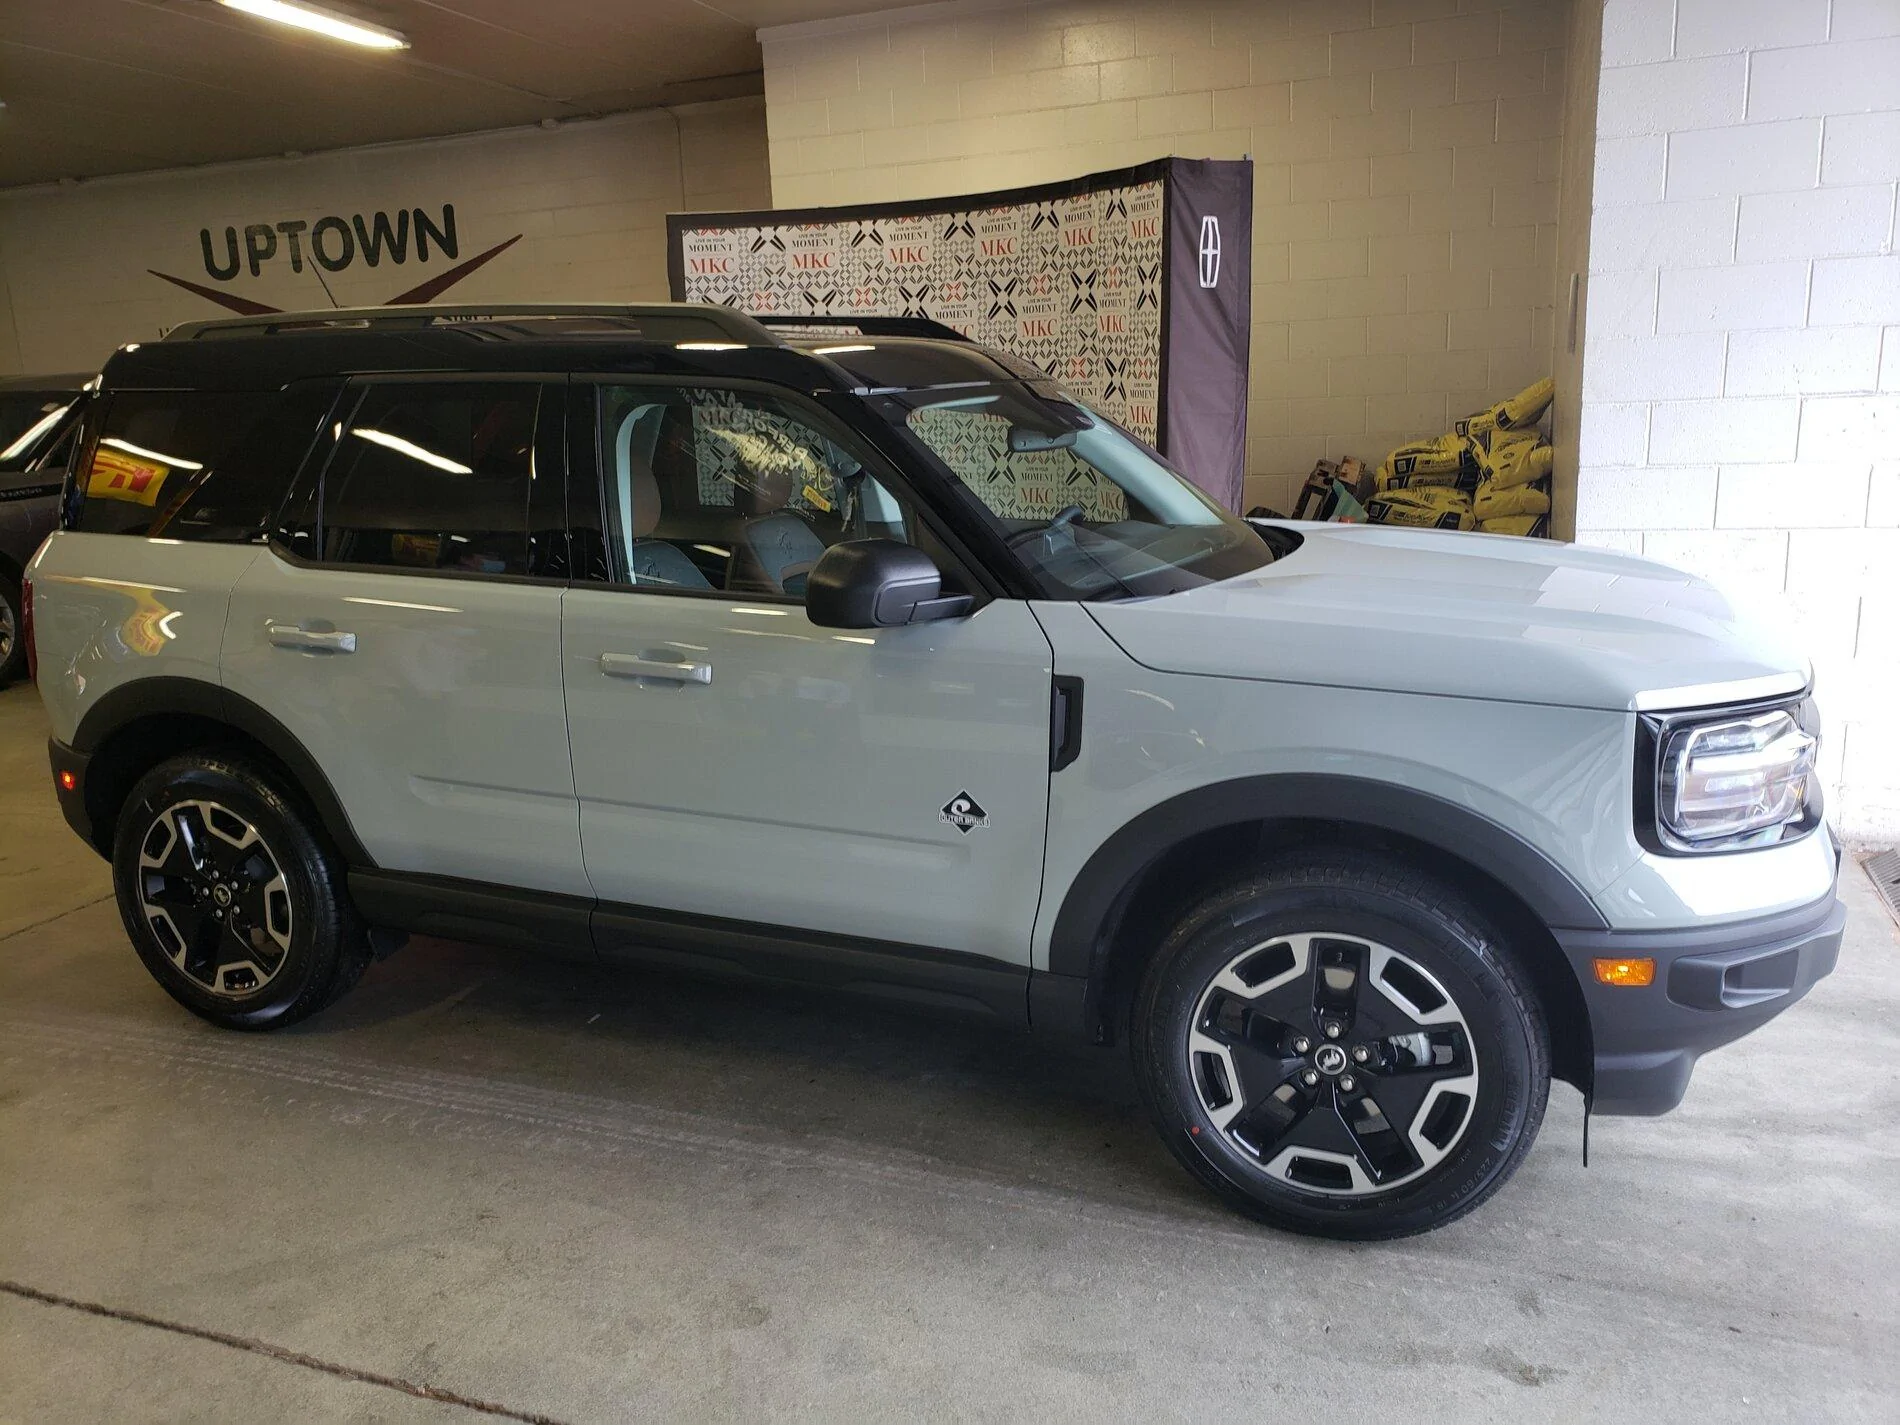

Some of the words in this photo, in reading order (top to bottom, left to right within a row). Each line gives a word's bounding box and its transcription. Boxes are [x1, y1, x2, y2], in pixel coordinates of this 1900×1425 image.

[1130, 199, 1159, 213] MOMENT
[1064, 209, 1096, 223] MOMENT
[981, 221, 1017, 234] MOMENT
[1131, 216, 1160, 239] MKC
[200, 204, 459, 281] UPTOWN
[792, 238, 835, 248] MOMENT
[889, 231, 928, 242] MOMENT
[1064, 226, 1097, 247] MKC
[689, 243, 732, 252] MOMENT
[980, 236, 1018, 257] MKC
[792, 251, 836, 270] MKC
[889, 245, 929, 264] MKC
[690, 257, 735, 274] MKC
[1022, 303, 1057, 315] MOMENT
[1099, 298, 1126, 309] MOMENT
[935, 309, 974, 320] MOMENT
[1022, 318, 1058, 338] MKC
[1099, 314, 1127, 333] MKC
[1073, 387, 1098, 397] MENT
[1129, 389, 1155, 400] MOMENT
[1130, 404, 1155, 425] MKC
[1020, 472, 1053, 482] MOMENT
[1020, 487, 1054, 505] MKC
